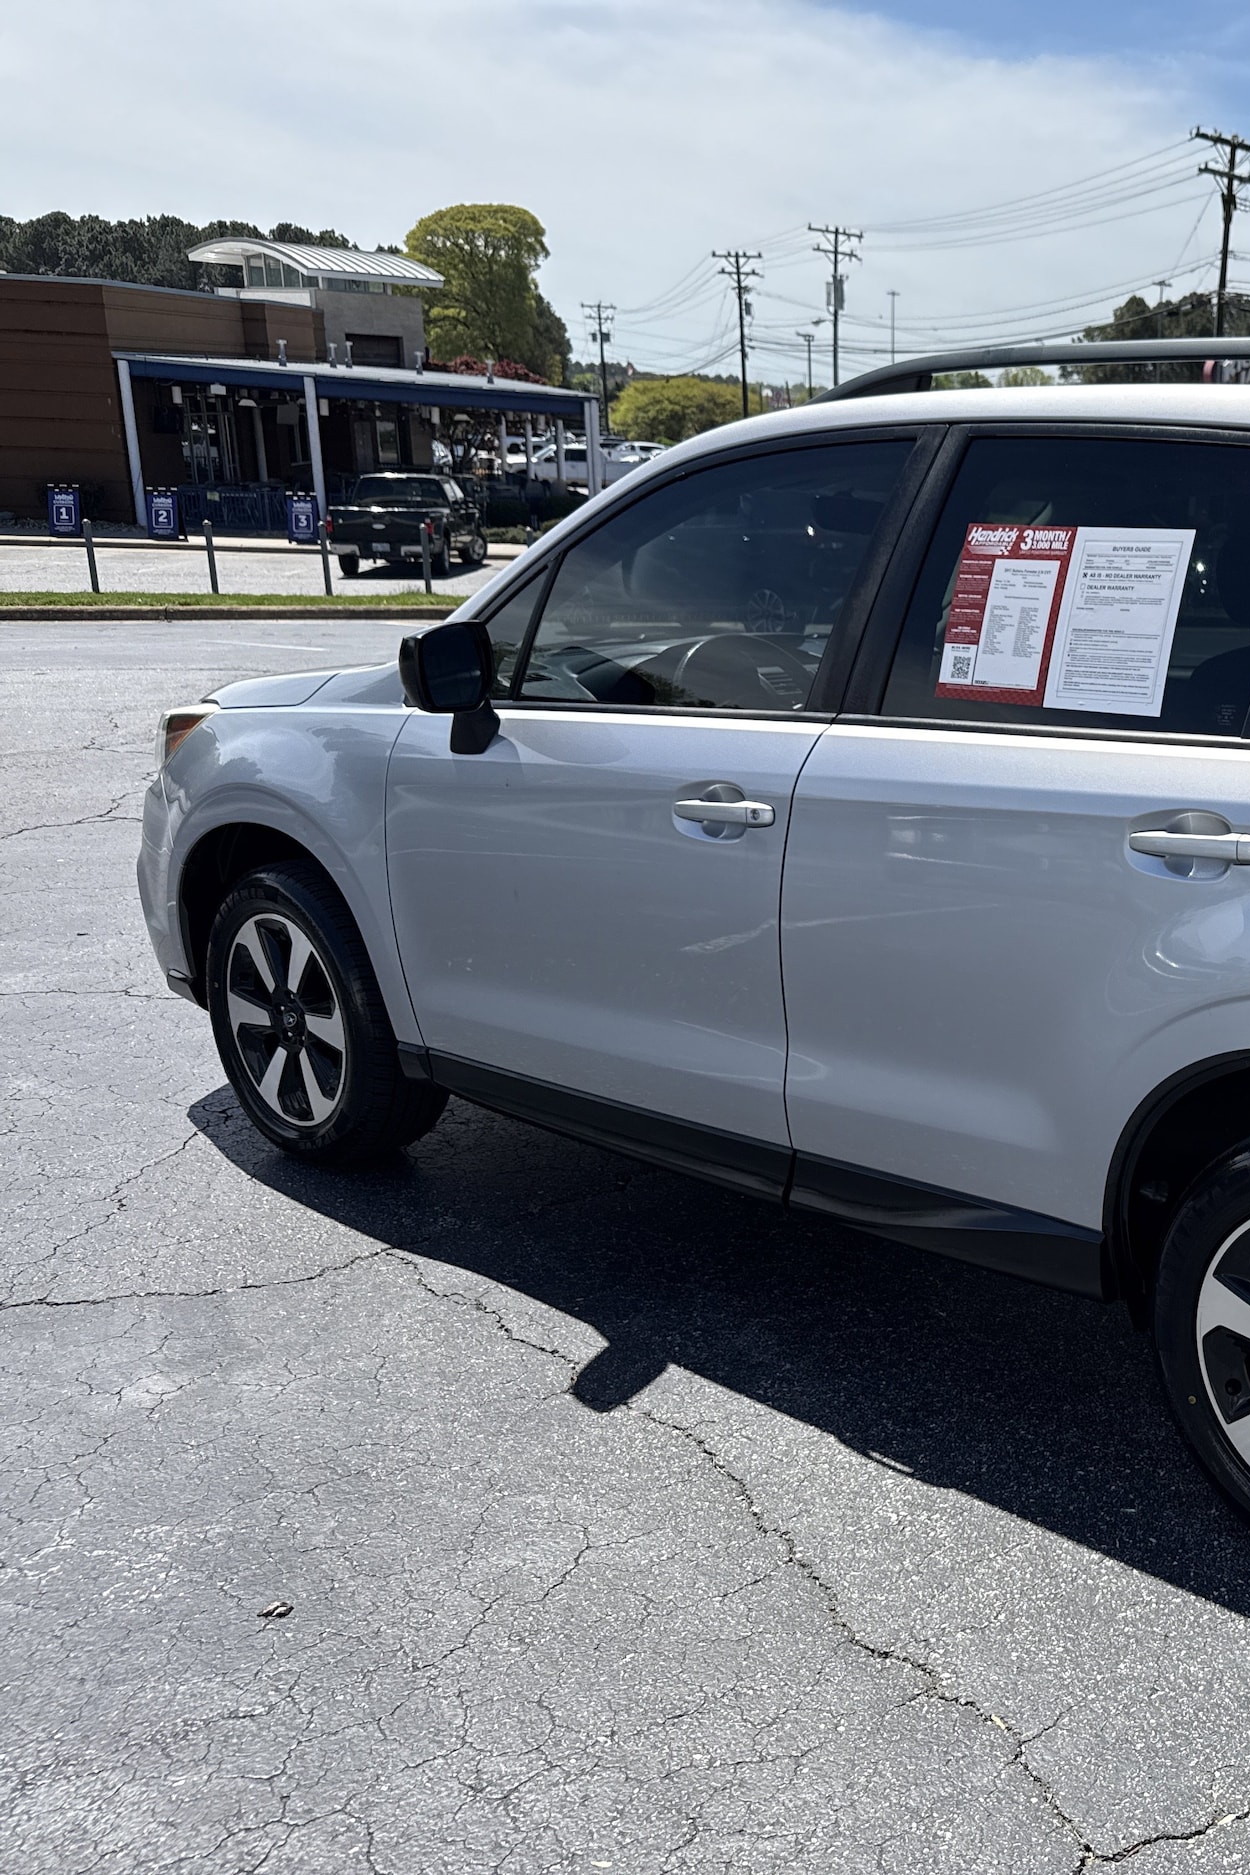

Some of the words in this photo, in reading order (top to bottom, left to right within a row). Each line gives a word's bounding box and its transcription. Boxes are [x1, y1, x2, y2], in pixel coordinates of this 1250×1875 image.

[60, 507, 69, 520] 1
[158, 510, 168, 523] 2
[298, 515, 308, 527] 3
[967, 526, 1019, 545] Hendrick
[1020, 529, 1034, 550] 3
[1051, 541, 1069, 551] MILE
